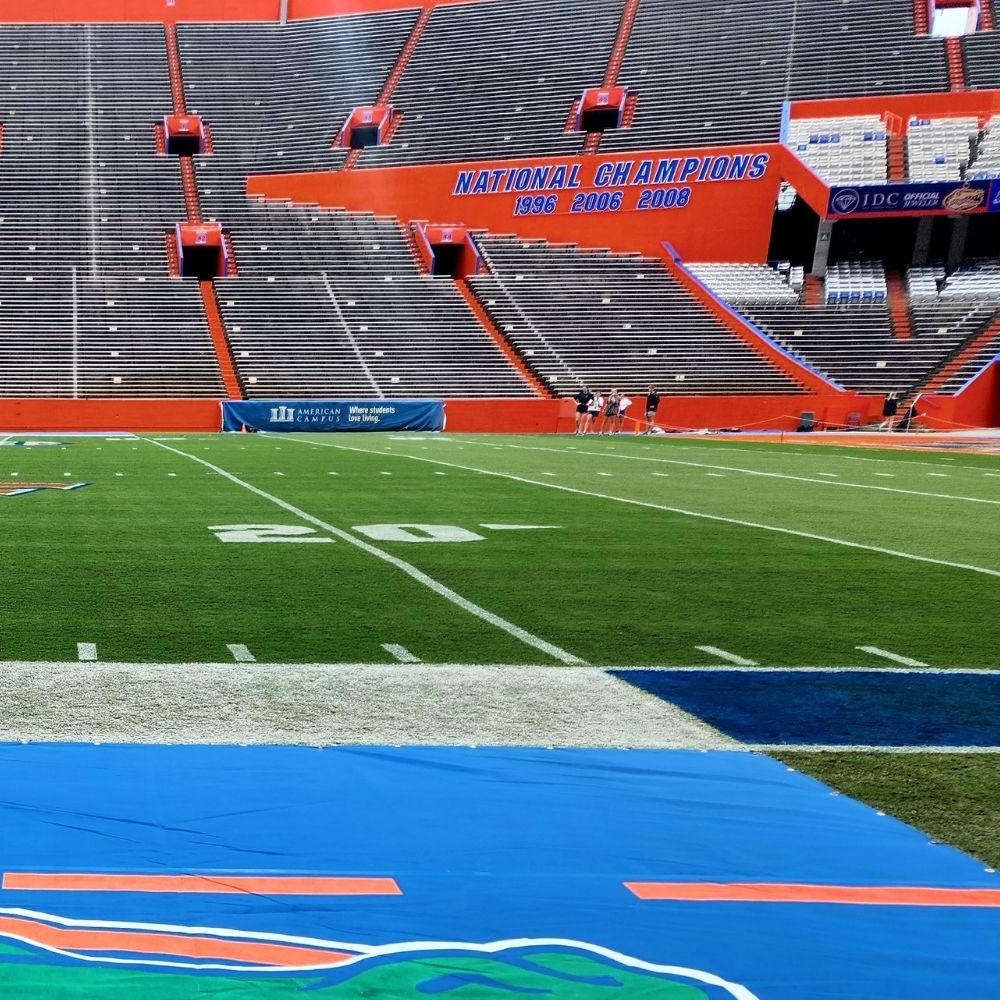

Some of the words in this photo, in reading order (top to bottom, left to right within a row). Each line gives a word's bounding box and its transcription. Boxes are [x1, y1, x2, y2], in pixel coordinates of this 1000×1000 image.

[452, 163, 582, 196] NATIONAL
[594, 153, 770, 187] CHAMPIONS
[513, 194, 558, 217] 1996
[570, 191, 623, 213] 2006
[637, 187, 693, 210] 2008
[862, 192, 899, 206] IDC
[903, 192, 940, 201] OFFICIAL
[349, 406, 369, 414] Where
[369, 406, 396, 414] students
[296, 415, 341, 423] CAMPUS
